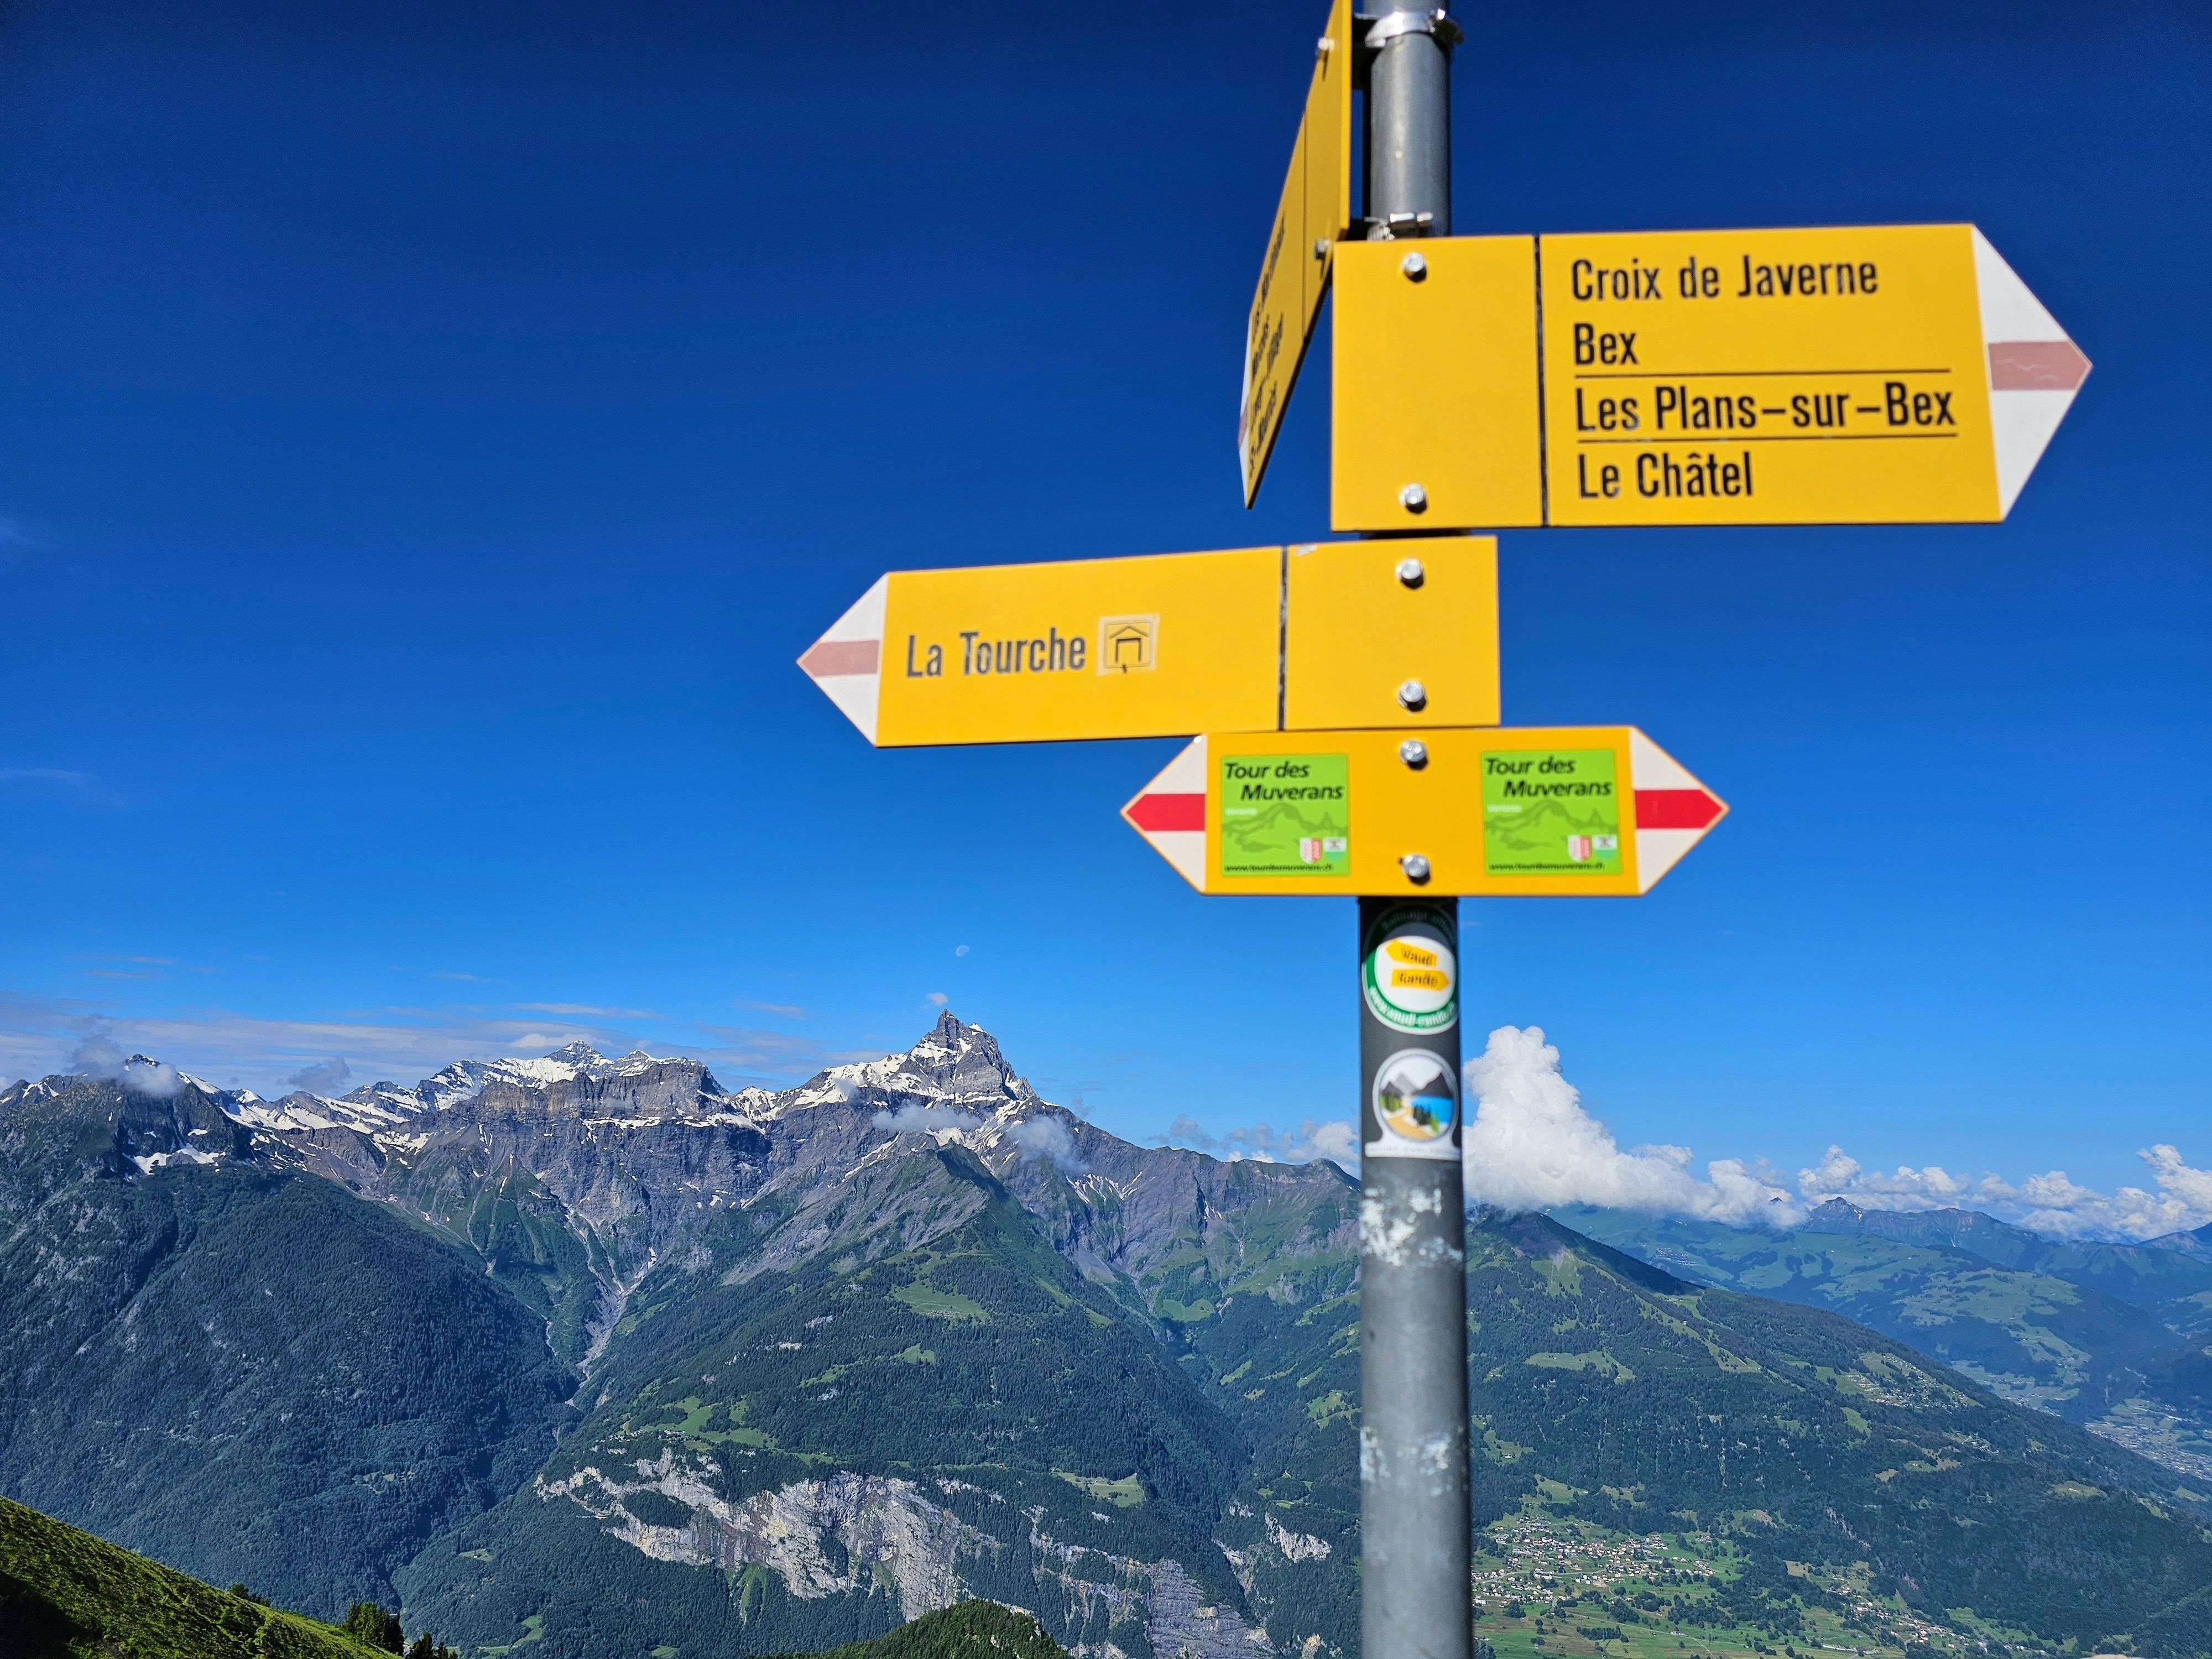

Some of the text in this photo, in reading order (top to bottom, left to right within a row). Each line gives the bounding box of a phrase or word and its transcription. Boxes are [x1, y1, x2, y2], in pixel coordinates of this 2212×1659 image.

[1572, 254, 1878, 301] Croix de Javerne
[1573, 322, 1639, 366] Bex
[1575, 388, 1639, 432] Les
[1578, 451, 1753, 498] Le Châtel
[906, 627, 1086, 679] La Tourche
[1225, 760, 1311, 779] Tour des
[1485, 755, 1575, 775] Tour des
[1240, 784, 1344, 801] Muverans
[1503, 780, 1612, 797] Muverans
